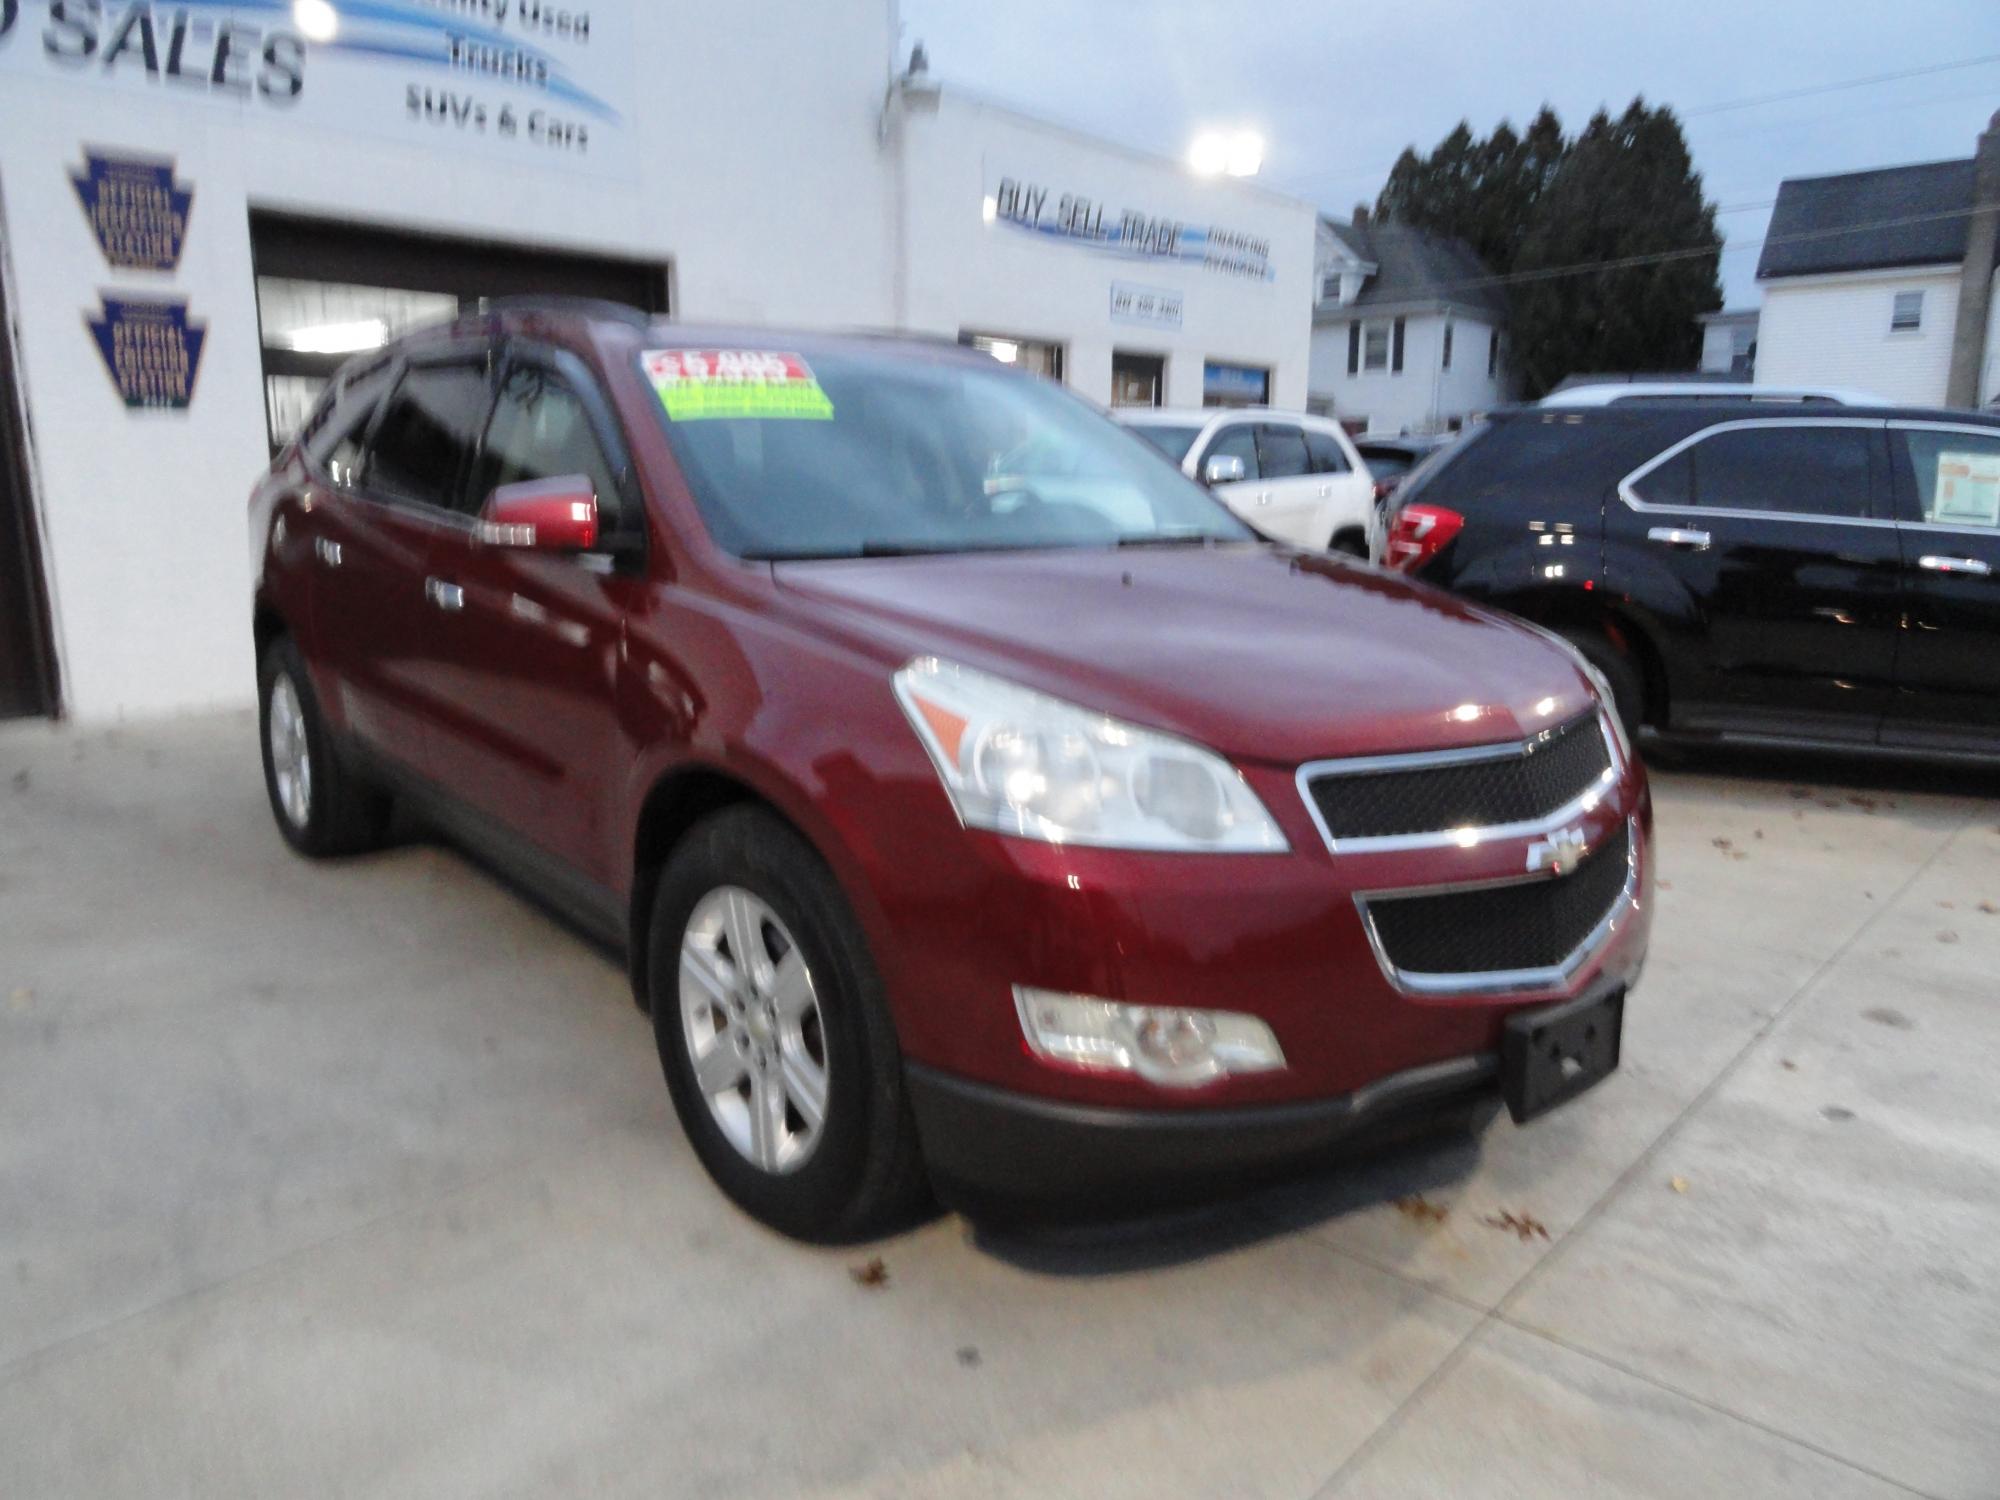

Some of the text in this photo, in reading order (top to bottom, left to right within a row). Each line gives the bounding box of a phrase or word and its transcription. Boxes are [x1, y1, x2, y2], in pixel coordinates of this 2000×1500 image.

[42, 0, 305, 108] SALES
[517, 0, 590, 43] Used
[448, 33, 547, 87] Trucks
[406, 84, 588, 150] SUVs & Cars
[996, 177, 1184, 258] BUY SELL TRADE
